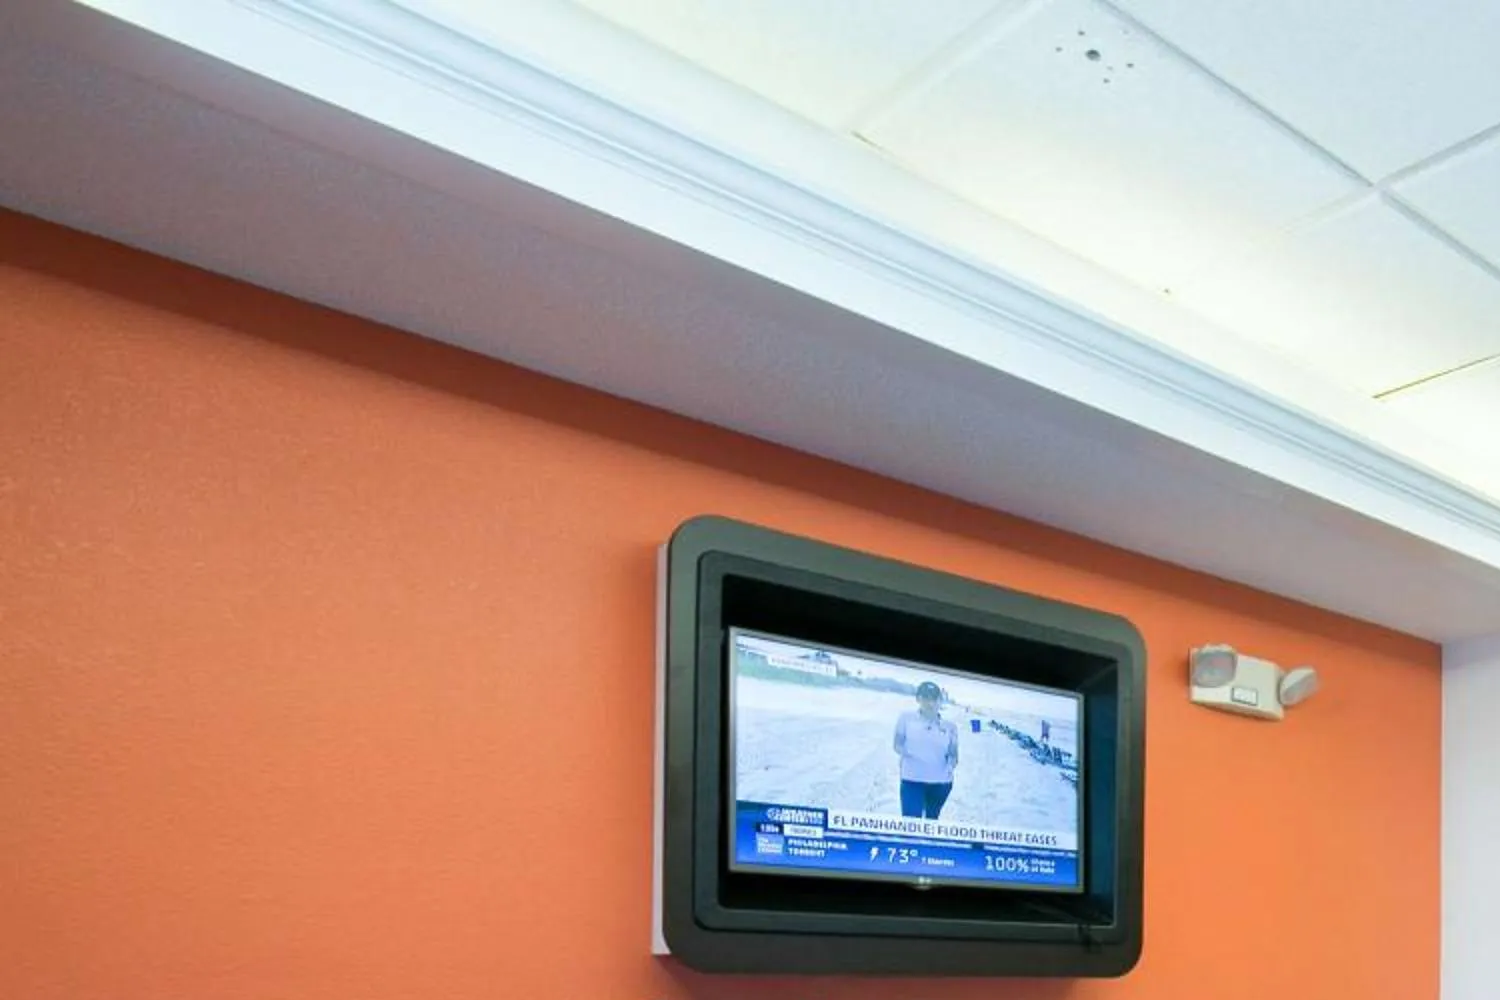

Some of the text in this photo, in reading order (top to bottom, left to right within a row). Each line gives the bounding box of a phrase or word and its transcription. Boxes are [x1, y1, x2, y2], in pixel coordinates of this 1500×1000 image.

[833, 815, 847, 828] FL
[937, 825, 977, 840] FLOOD
[980, 829, 1023, 843] THREAT
[1025, 833, 1057, 847] EASES
[984, 855, 1030, 873] 100%
